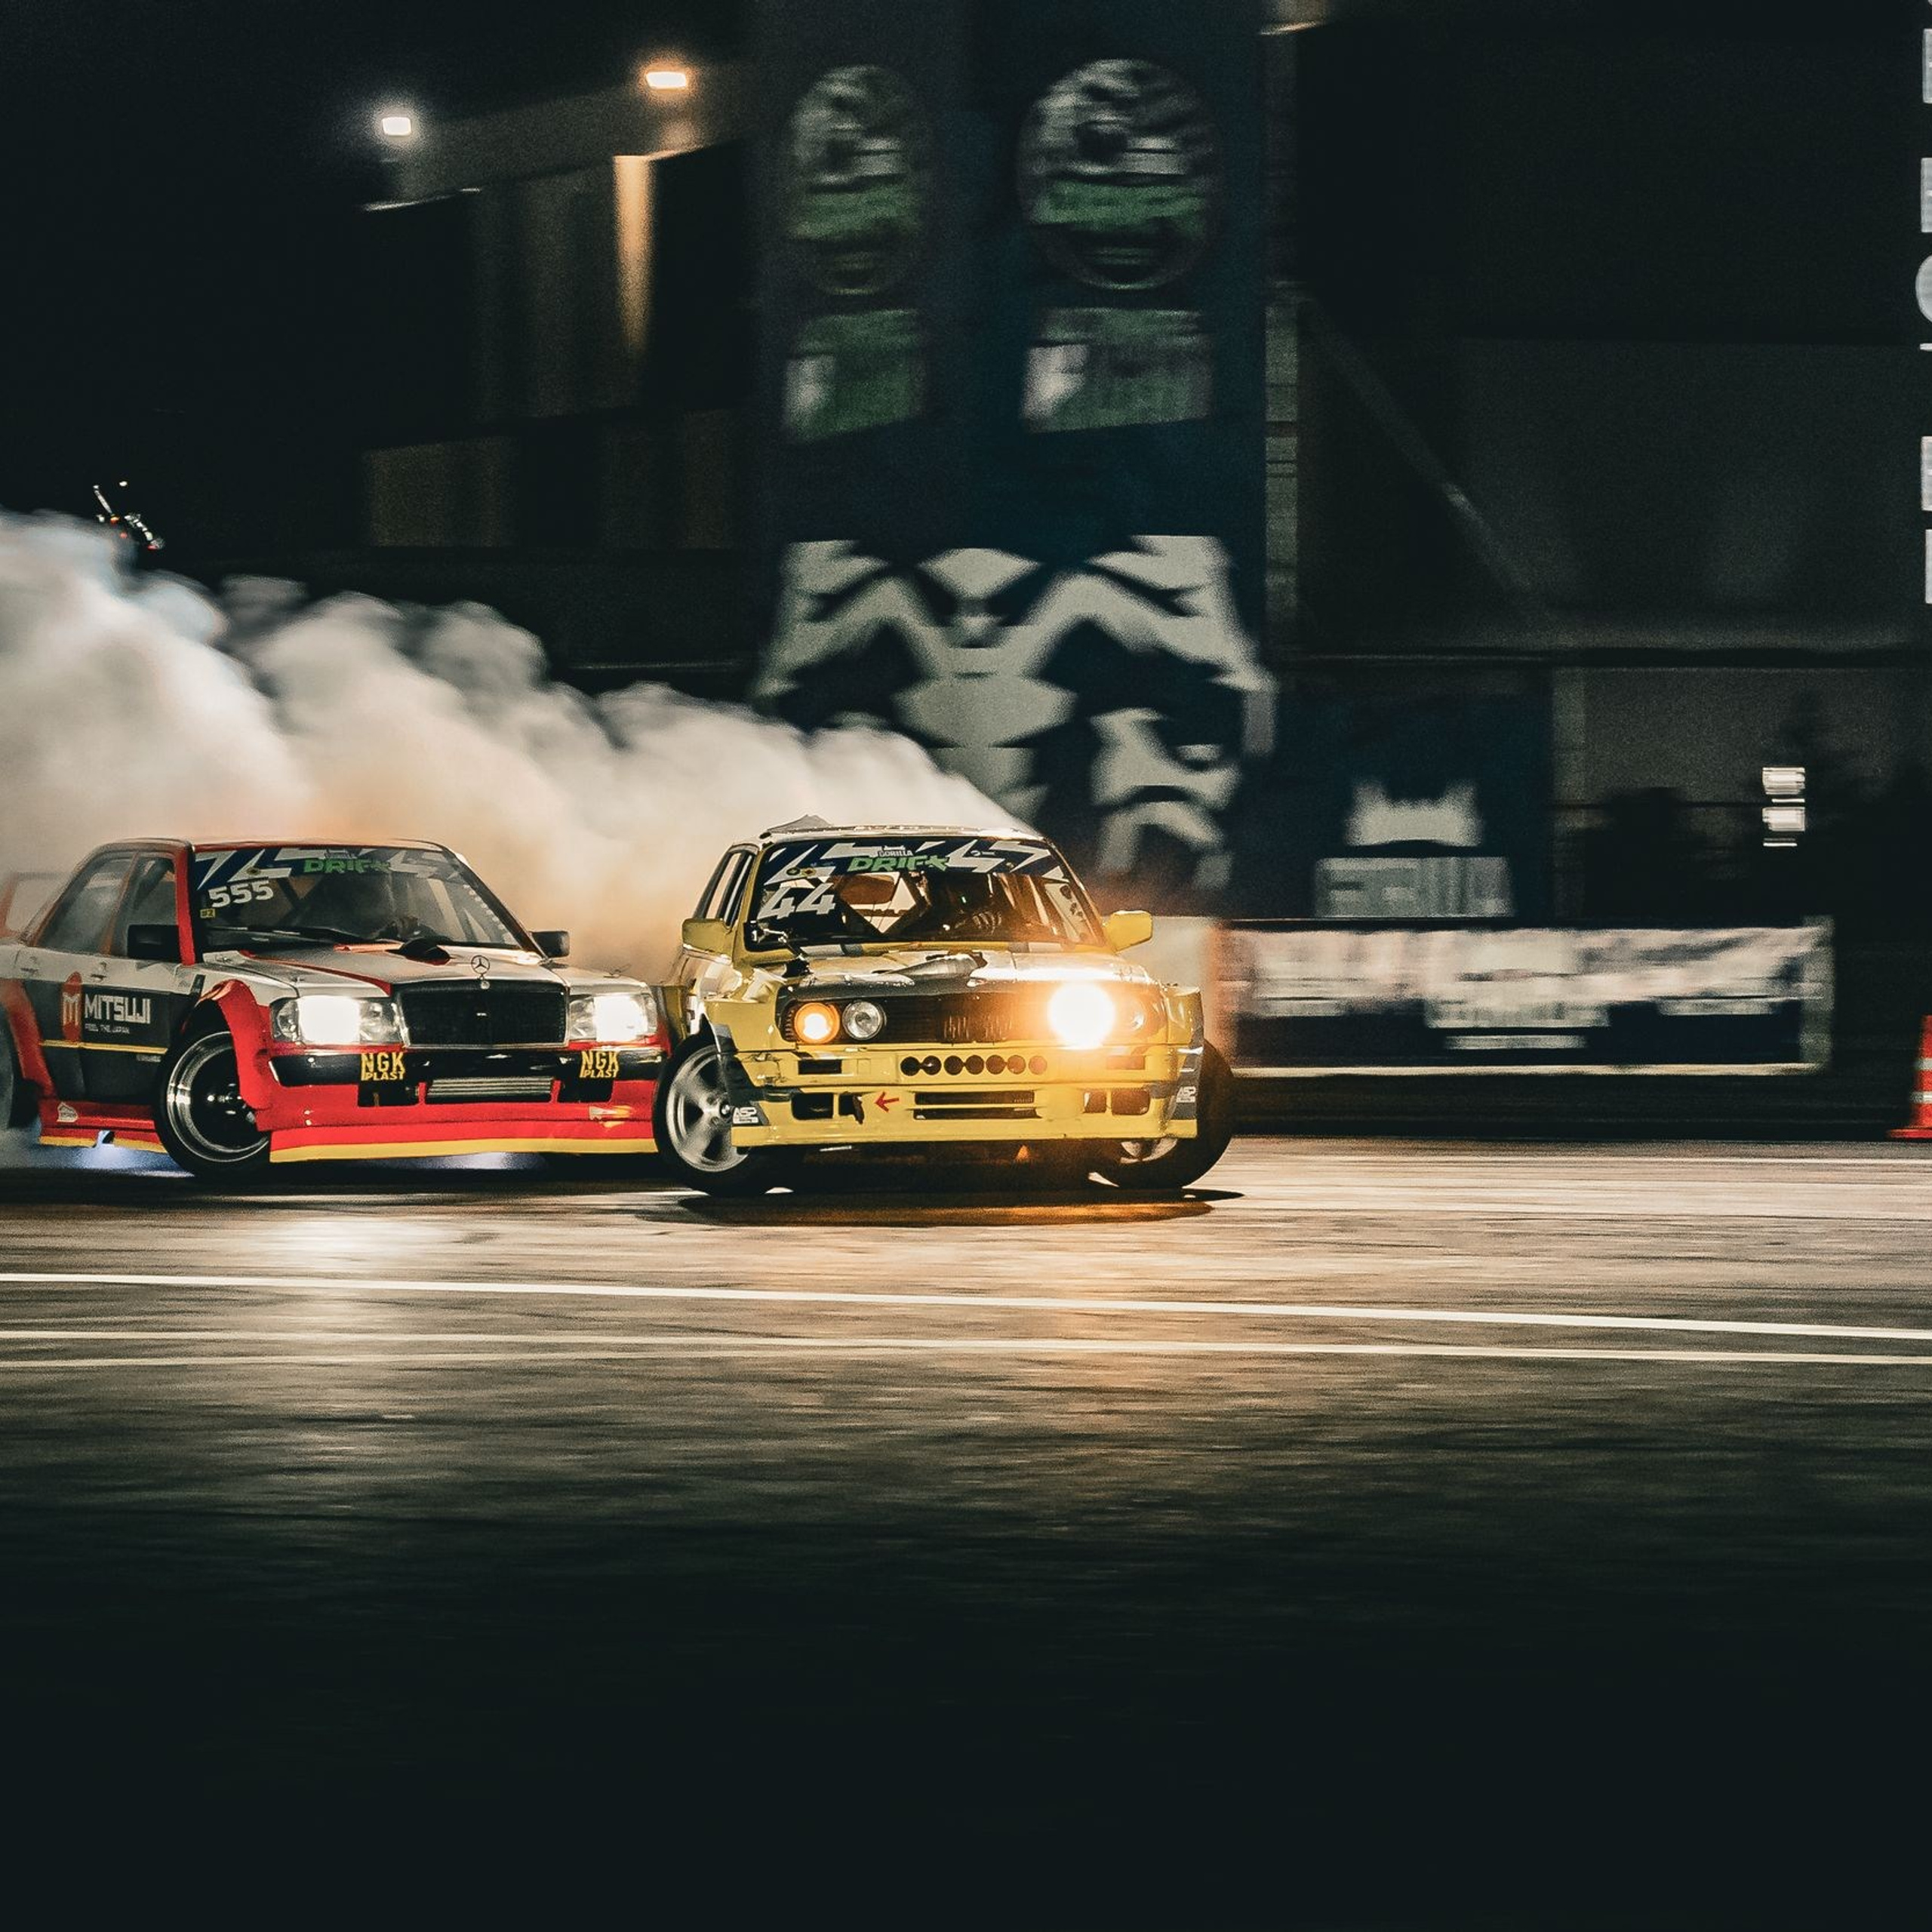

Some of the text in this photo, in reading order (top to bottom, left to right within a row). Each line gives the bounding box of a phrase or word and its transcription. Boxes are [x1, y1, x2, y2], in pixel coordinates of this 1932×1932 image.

[208, 880, 274, 908] 555
[757, 882, 837, 920] 44
[361, 1052, 405, 1072] NGK
[580, 1051, 619, 1070] NGK
[365, 1071, 405, 1081] PLAST
[583, 1069, 619, 1078] PLAST
